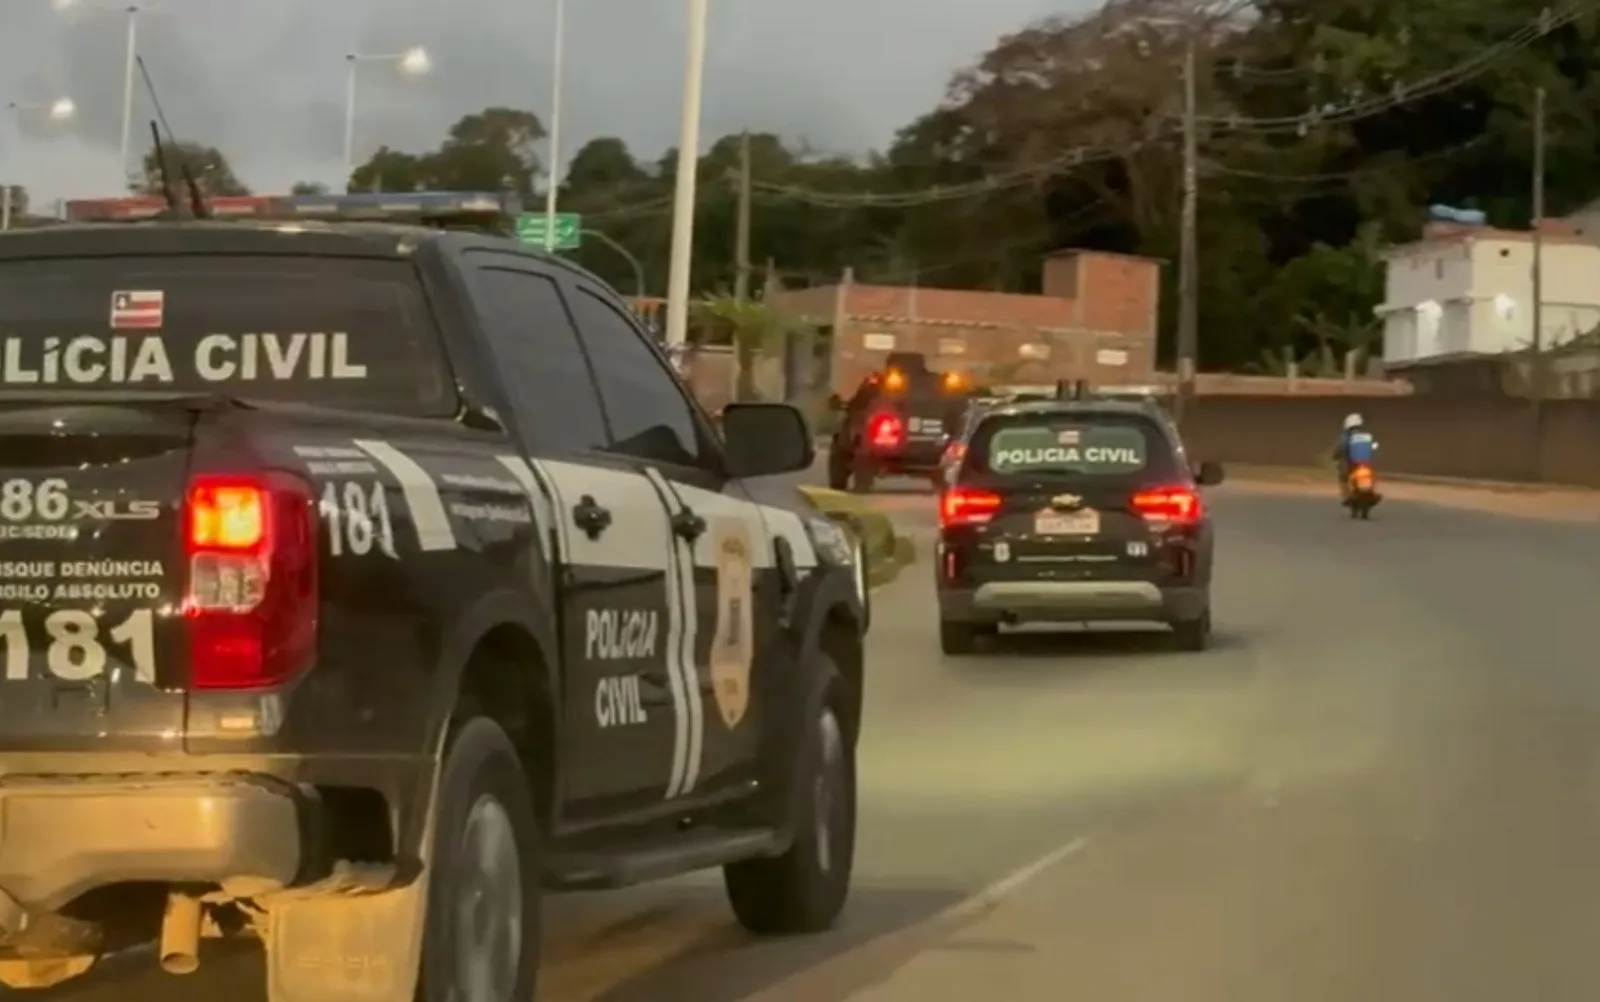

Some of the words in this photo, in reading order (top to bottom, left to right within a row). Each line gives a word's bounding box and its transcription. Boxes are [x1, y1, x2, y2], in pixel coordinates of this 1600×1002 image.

[195, 333, 367, 380] CIVIL
[1084, 447, 1141, 464] CIVIL
[72, 500, 160, 519] XLS
[318, 481, 400, 560] 181
[61, 557, 164, 577] DENÚNCIA
[54, 583, 160, 599] ABSOLUTO
[0, 609, 155, 685] 181
[595, 675, 647, 727] CIVIL
